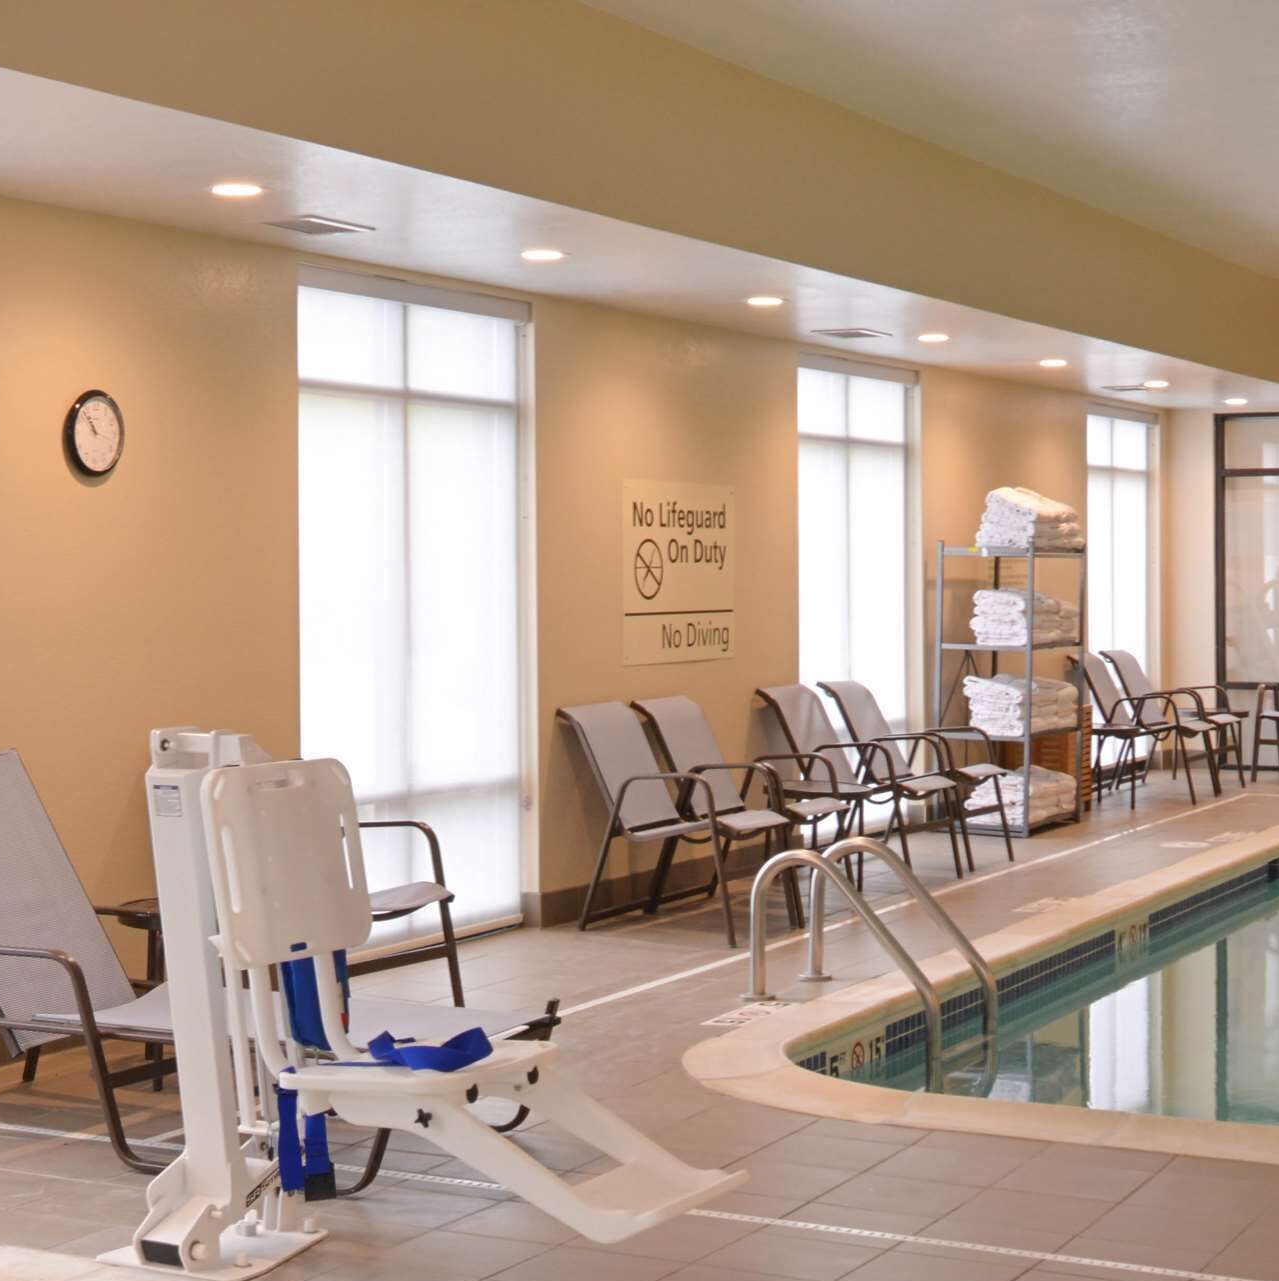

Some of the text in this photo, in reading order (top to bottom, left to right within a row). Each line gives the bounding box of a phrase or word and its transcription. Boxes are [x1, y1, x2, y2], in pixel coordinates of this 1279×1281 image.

[632, 501, 727, 536] No Lifeguard
[668, 538, 727, 570] On Duty
[662, 621, 730, 652] No Diving
